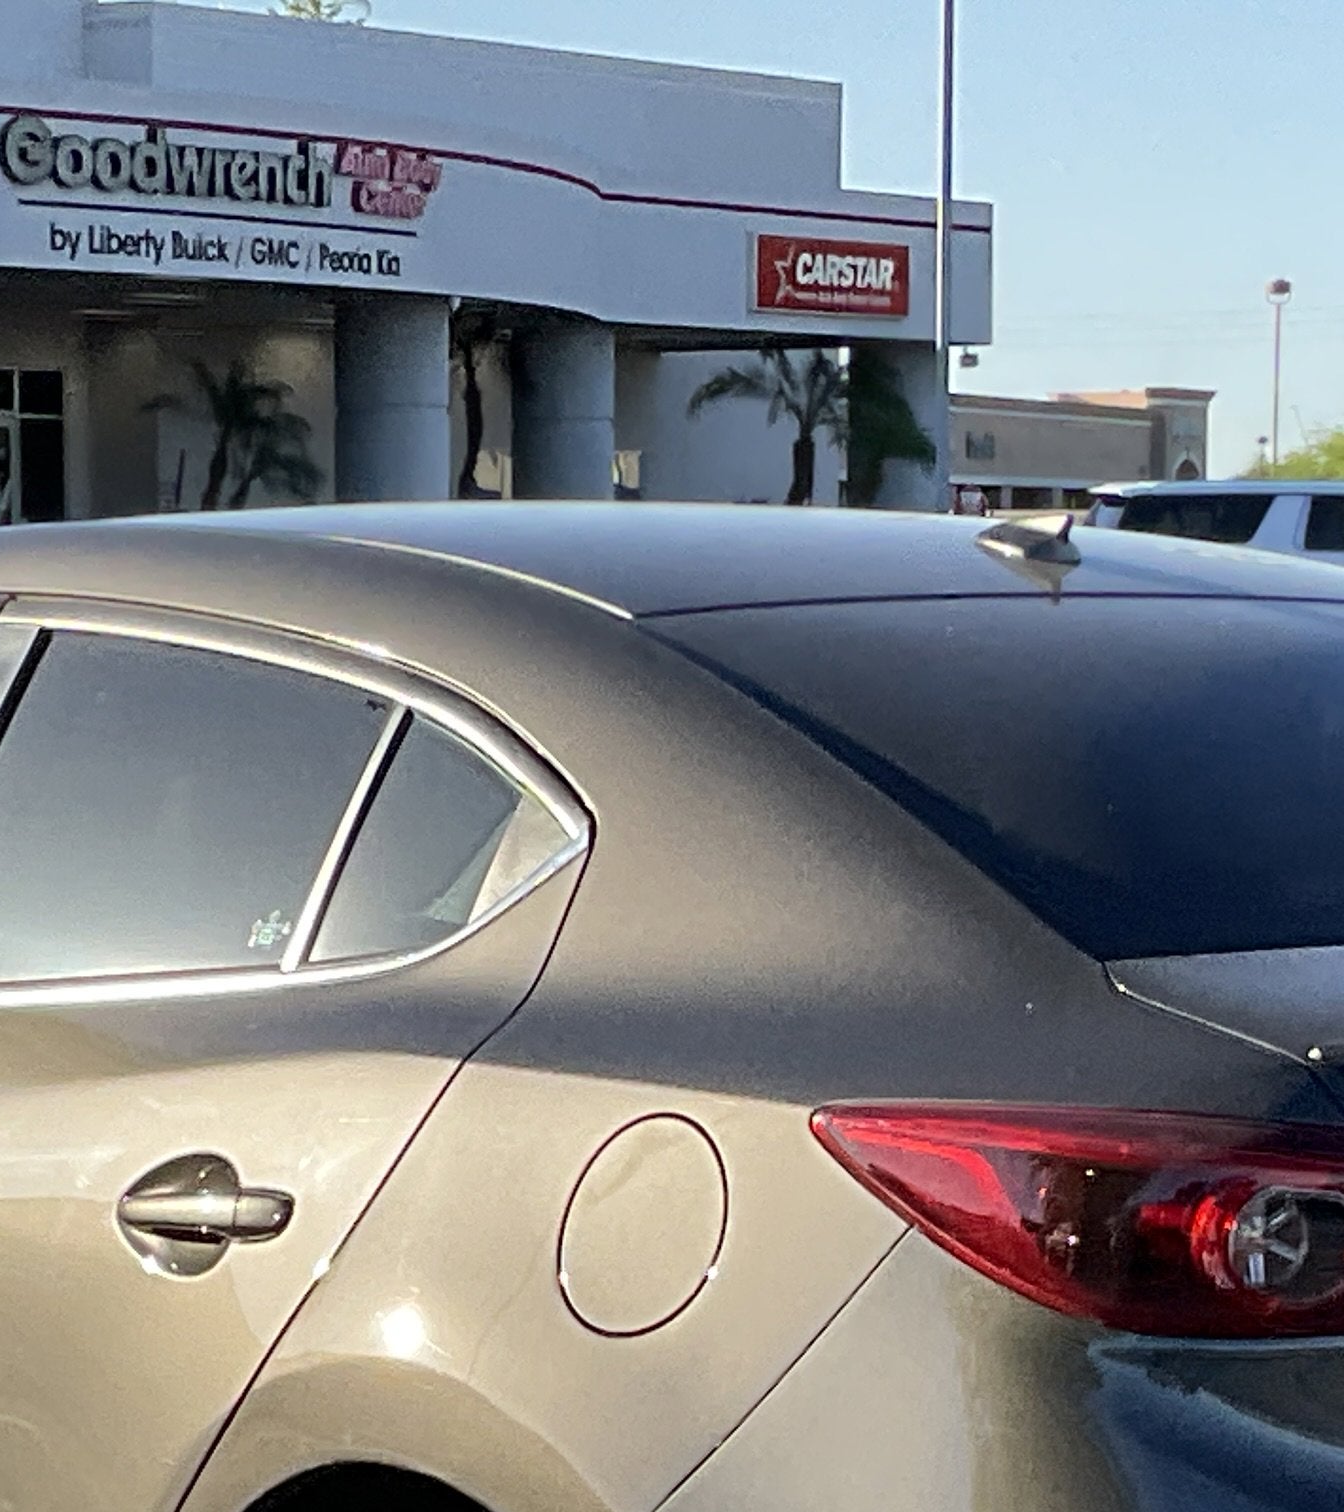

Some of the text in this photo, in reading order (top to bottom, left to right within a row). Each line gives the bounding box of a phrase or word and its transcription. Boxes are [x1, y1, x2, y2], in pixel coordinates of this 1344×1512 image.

[49, 221, 81, 261] by
[87, 224, 166, 267] Liberty
[171, 230, 230, 263] Buick
[250, 237, 300, 269] GMC
[319, 242, 372, 275] Peoria
[376, 249, 401, 277] Kia
[796, 252, 895, 291] CARSTAR
